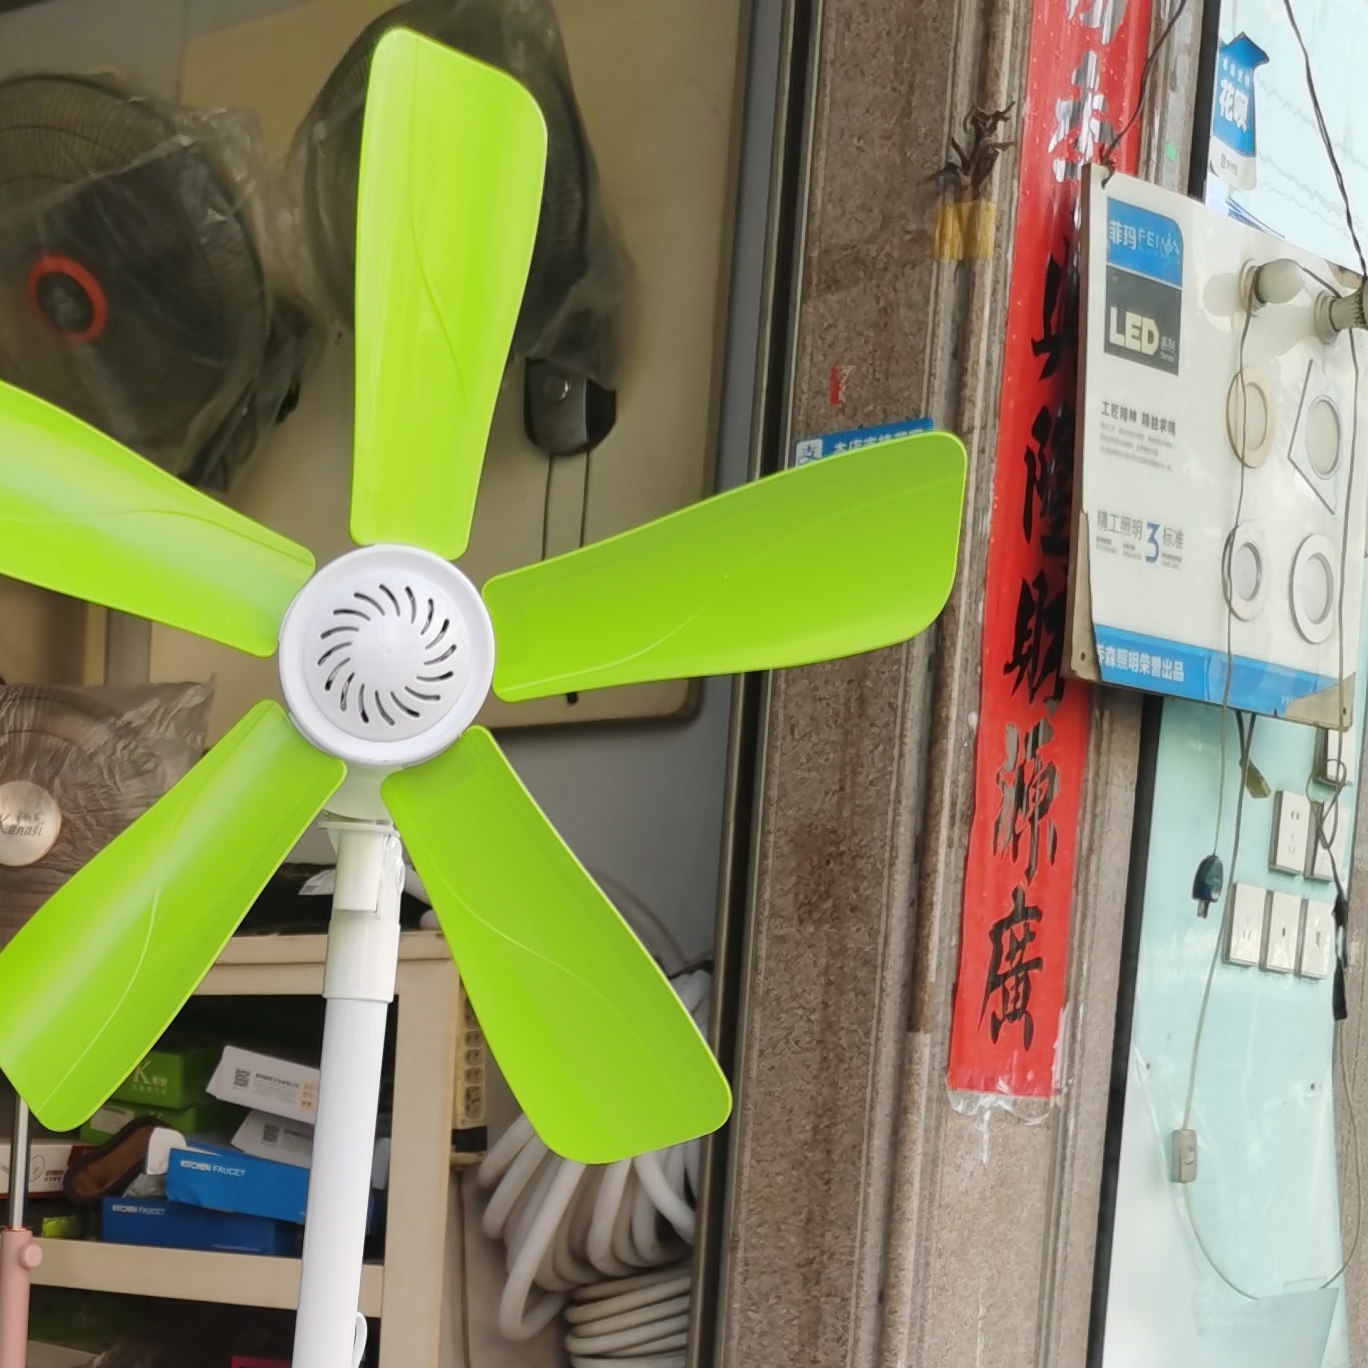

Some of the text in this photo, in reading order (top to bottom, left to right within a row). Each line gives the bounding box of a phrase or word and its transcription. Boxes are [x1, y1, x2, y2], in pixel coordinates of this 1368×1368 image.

[1109, 306, 1159, 356] LED
[1101, 401, 1137, 423] 工匠精神
[1141, 411, 1176, 436] 精益求精
[213, 1165, 245, 1177] FAUCET
